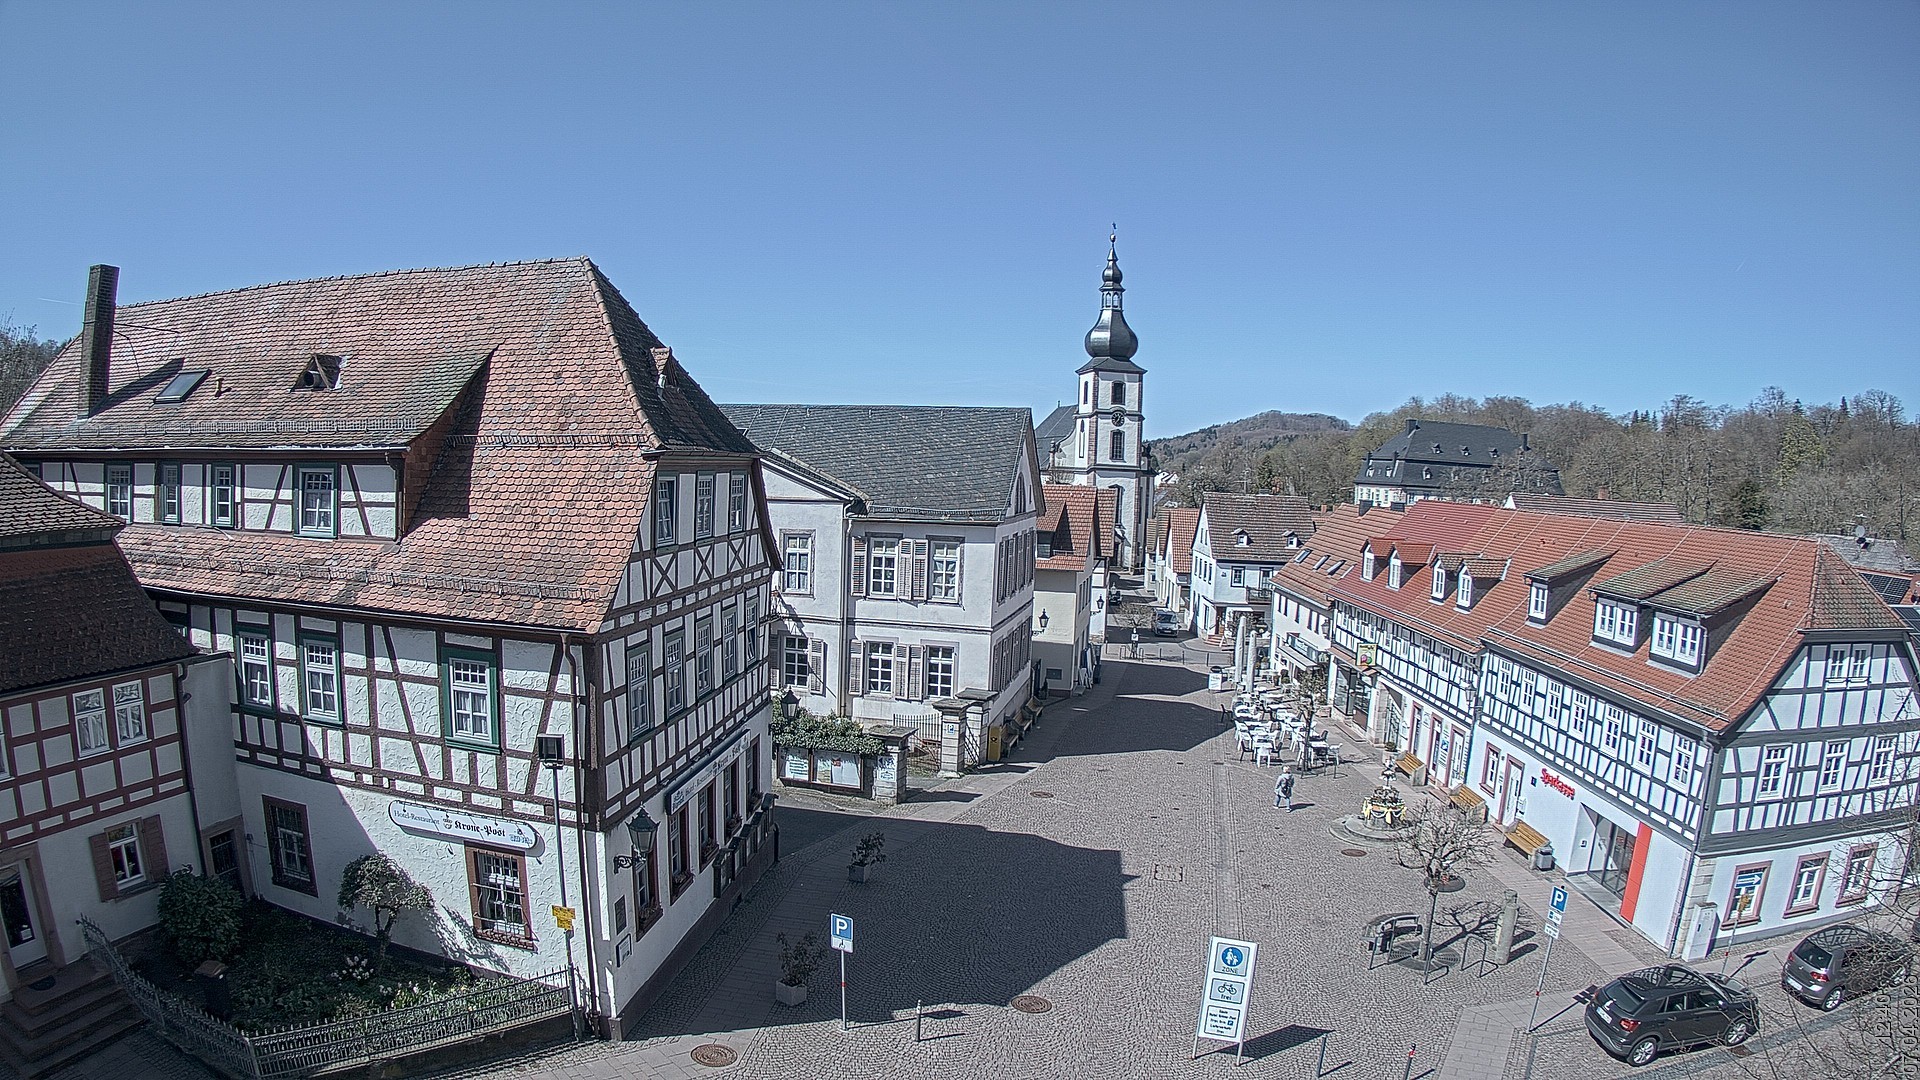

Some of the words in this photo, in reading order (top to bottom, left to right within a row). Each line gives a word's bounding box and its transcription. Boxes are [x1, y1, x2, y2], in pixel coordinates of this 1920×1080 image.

[1541, 768, 1575, 798] Sparkasse
[454, 820, 506, 837] Krone-Post
[1553, 890, 1564, 906] P
[836, 918, 848, 935] P
[1221, 966, 1238, 974] ZONE
[1220, 993, 1232, 1001] frei
